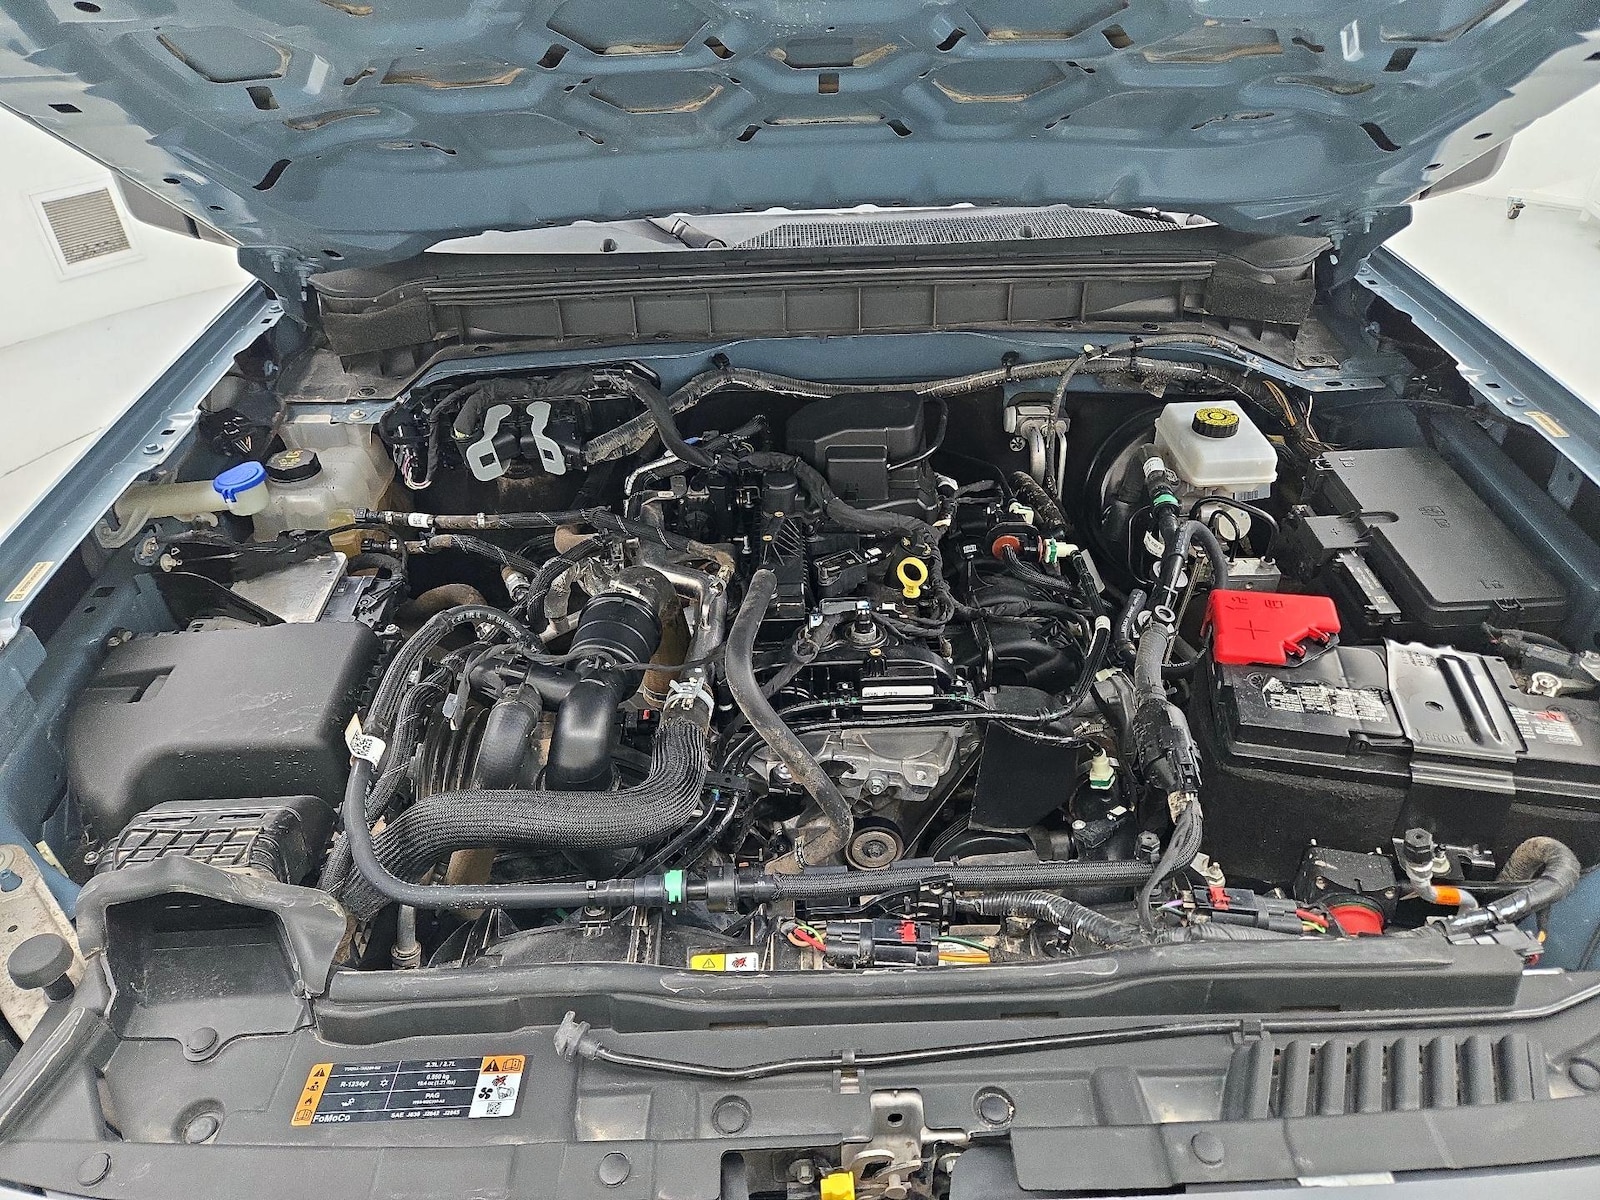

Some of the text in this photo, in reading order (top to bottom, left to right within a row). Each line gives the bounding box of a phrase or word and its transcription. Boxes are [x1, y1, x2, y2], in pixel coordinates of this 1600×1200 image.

[1424, 732, 1466, 745] FRONT
[340, 1080, 370, 1088] R-1234yf
[312, 1113, 351, 1123] FoMoCo
